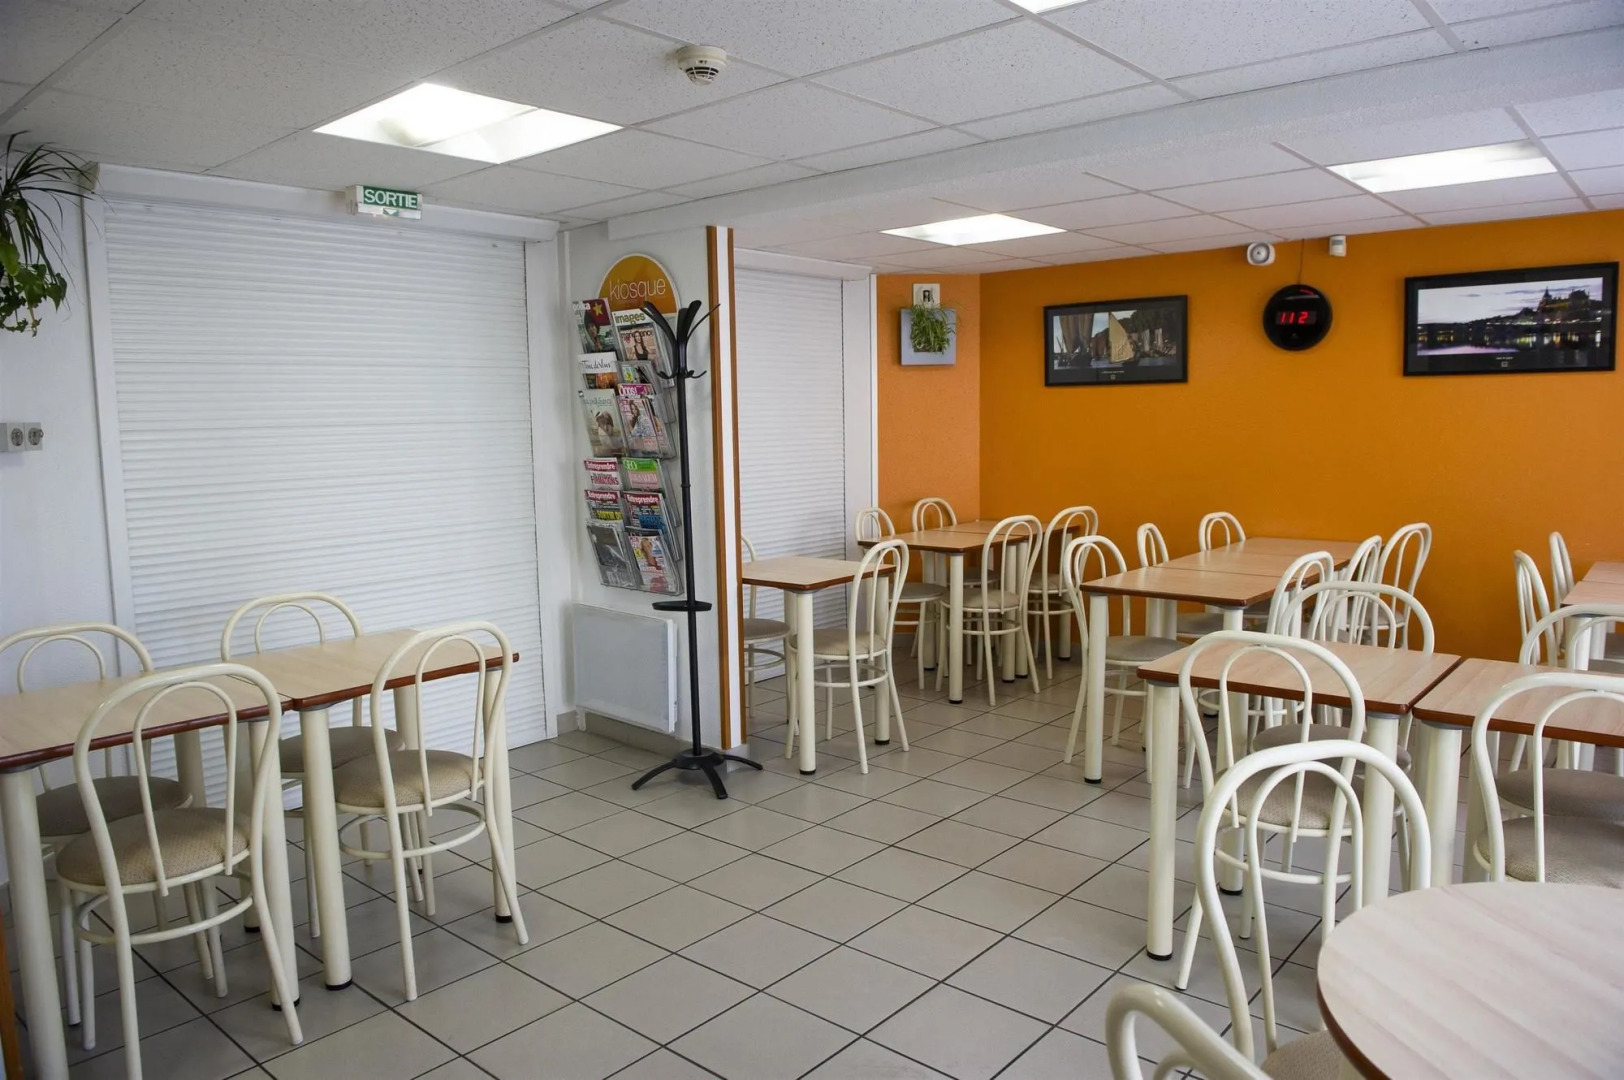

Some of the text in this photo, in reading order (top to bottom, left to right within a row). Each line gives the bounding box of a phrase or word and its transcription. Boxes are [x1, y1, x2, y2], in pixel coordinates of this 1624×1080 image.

[364, 189, 417, 209] SORTIE
[609, 279, 666, 301] kiosque
[614, 312, 646, 325] images
[627, 493, 659, 505] Entreprendre
